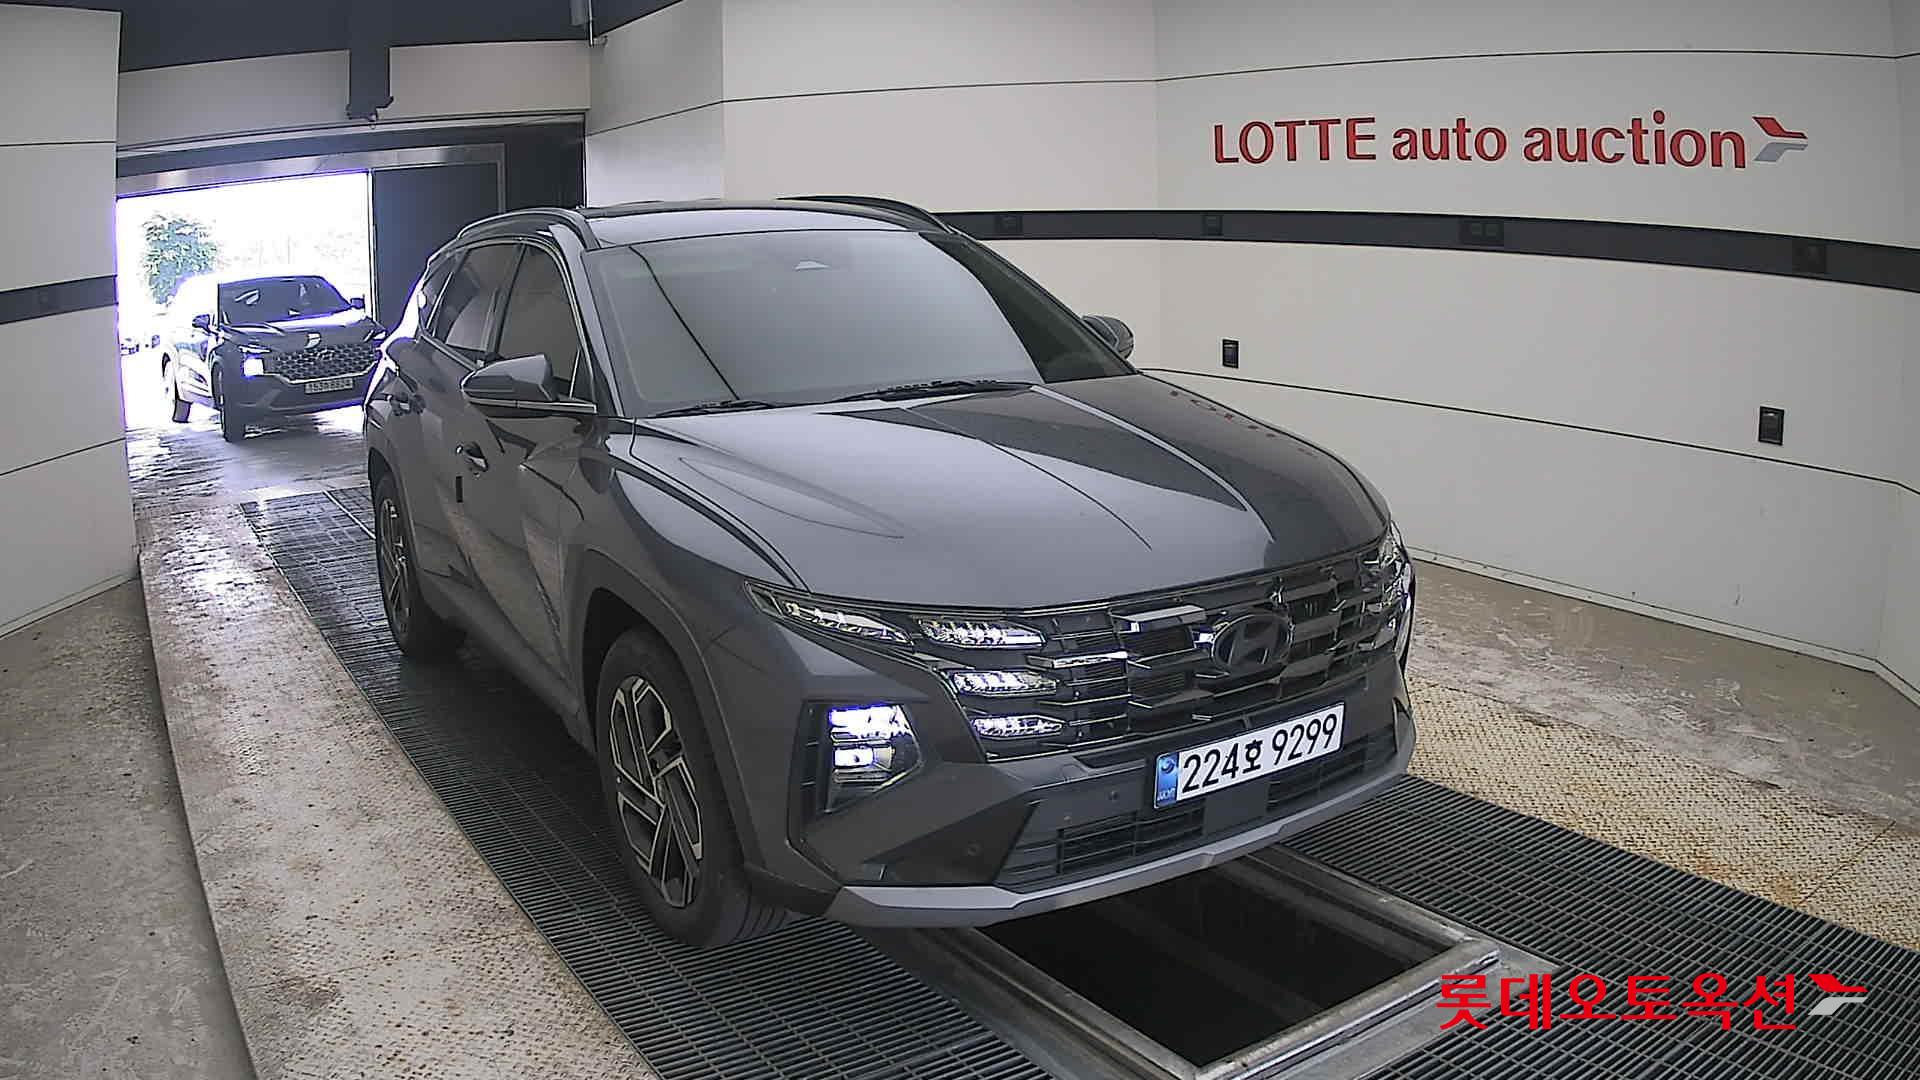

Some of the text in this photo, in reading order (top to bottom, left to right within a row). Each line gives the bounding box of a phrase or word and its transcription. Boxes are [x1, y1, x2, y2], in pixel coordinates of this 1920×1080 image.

[1214, 110, 1746, 169] LOTTE auto auction
[1182, 713, 1337, 793] 224호 9299
